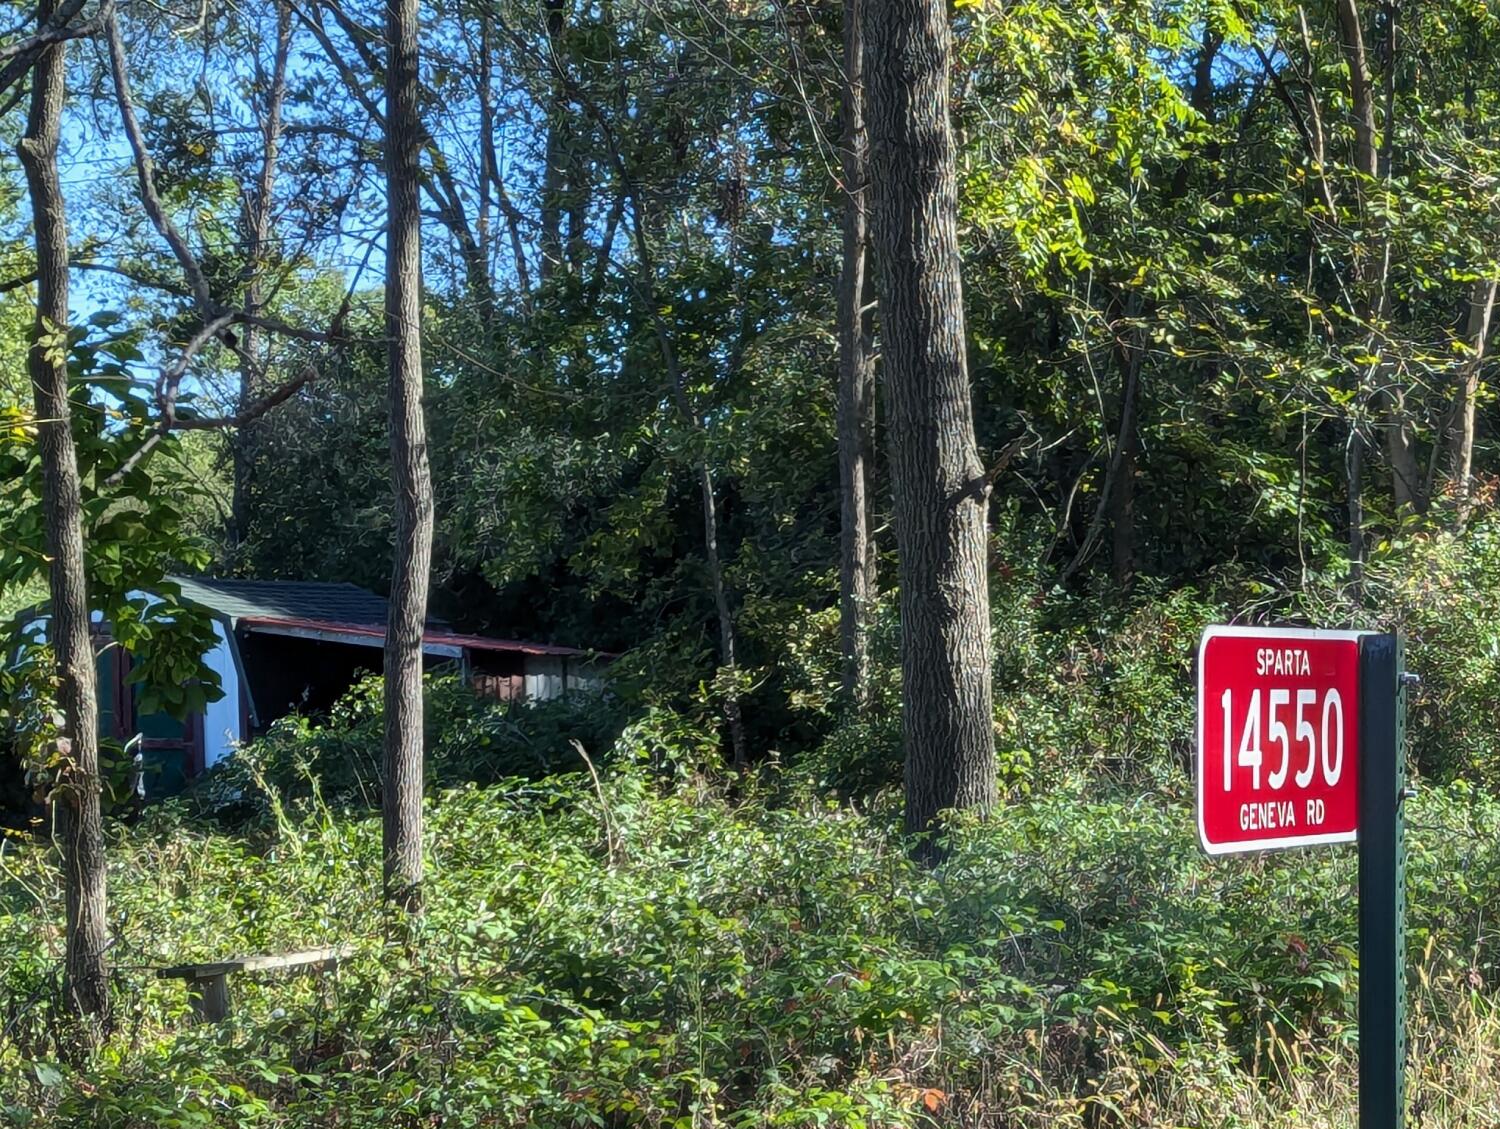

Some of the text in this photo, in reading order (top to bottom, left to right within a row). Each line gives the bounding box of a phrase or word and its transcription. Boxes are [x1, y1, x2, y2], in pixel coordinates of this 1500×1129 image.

[1256, 649, 1310, 676] SPARTA
[1221, 687, 1344, 792] 14550
[1240, 799, 1325, 831] GENEVA RD
